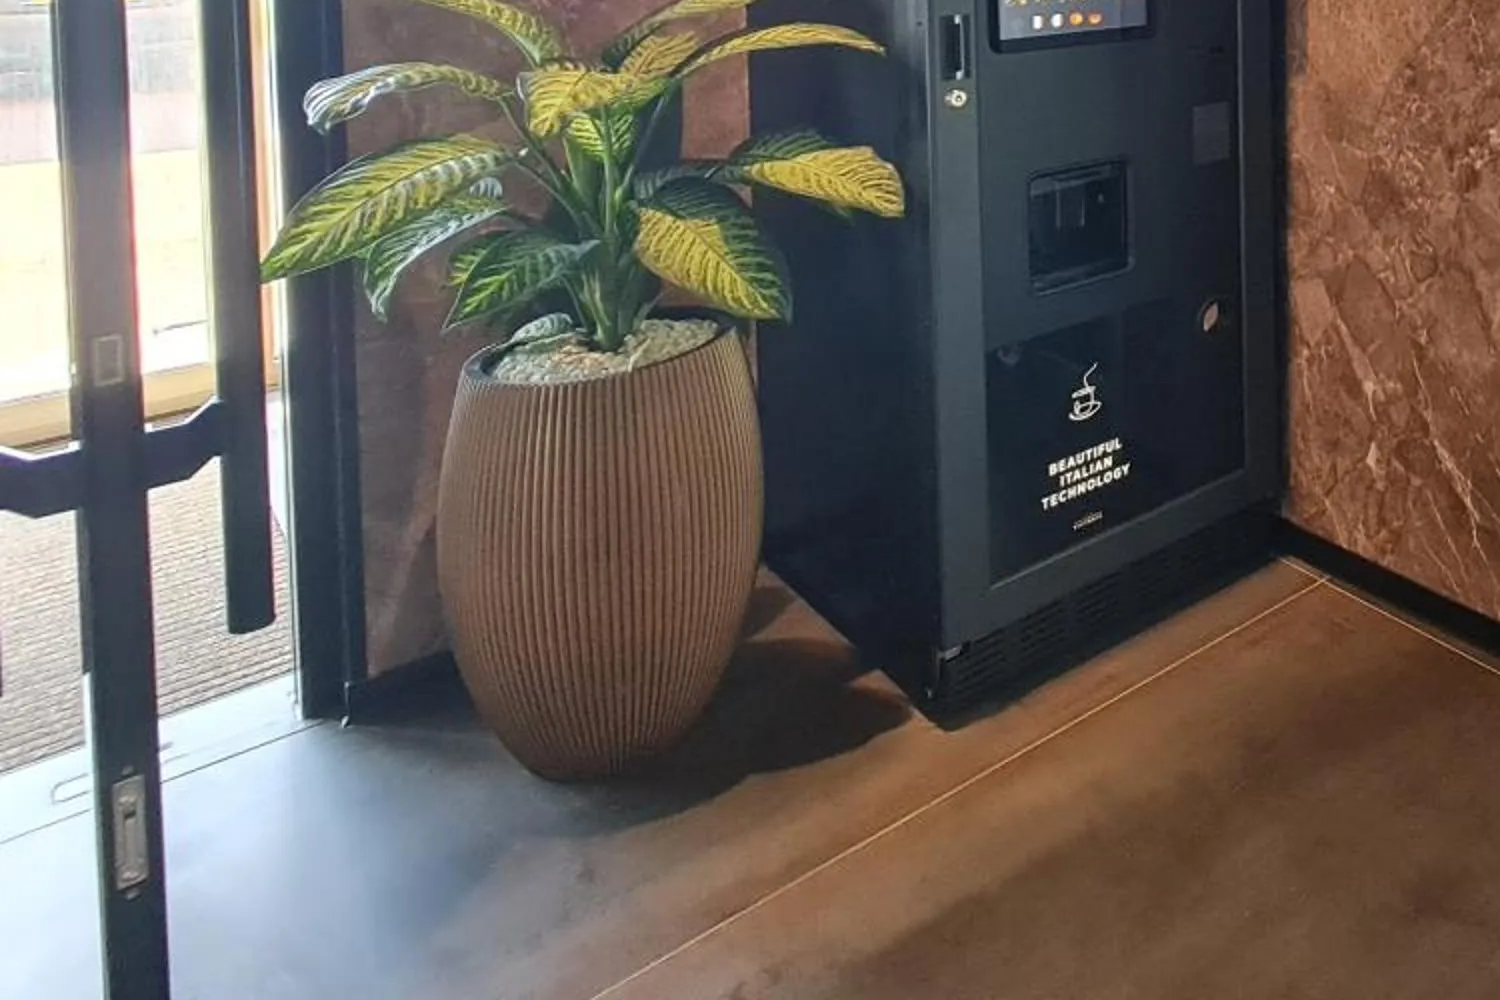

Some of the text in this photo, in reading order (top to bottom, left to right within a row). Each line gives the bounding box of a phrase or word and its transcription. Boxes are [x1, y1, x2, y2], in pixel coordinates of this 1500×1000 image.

[1048, 437, 1122, 476] BEAUTIFUL
[1060, 455, 1113, 487] ITALIAN
[1041, 462, 1131, 510] TECHNOLOGY
